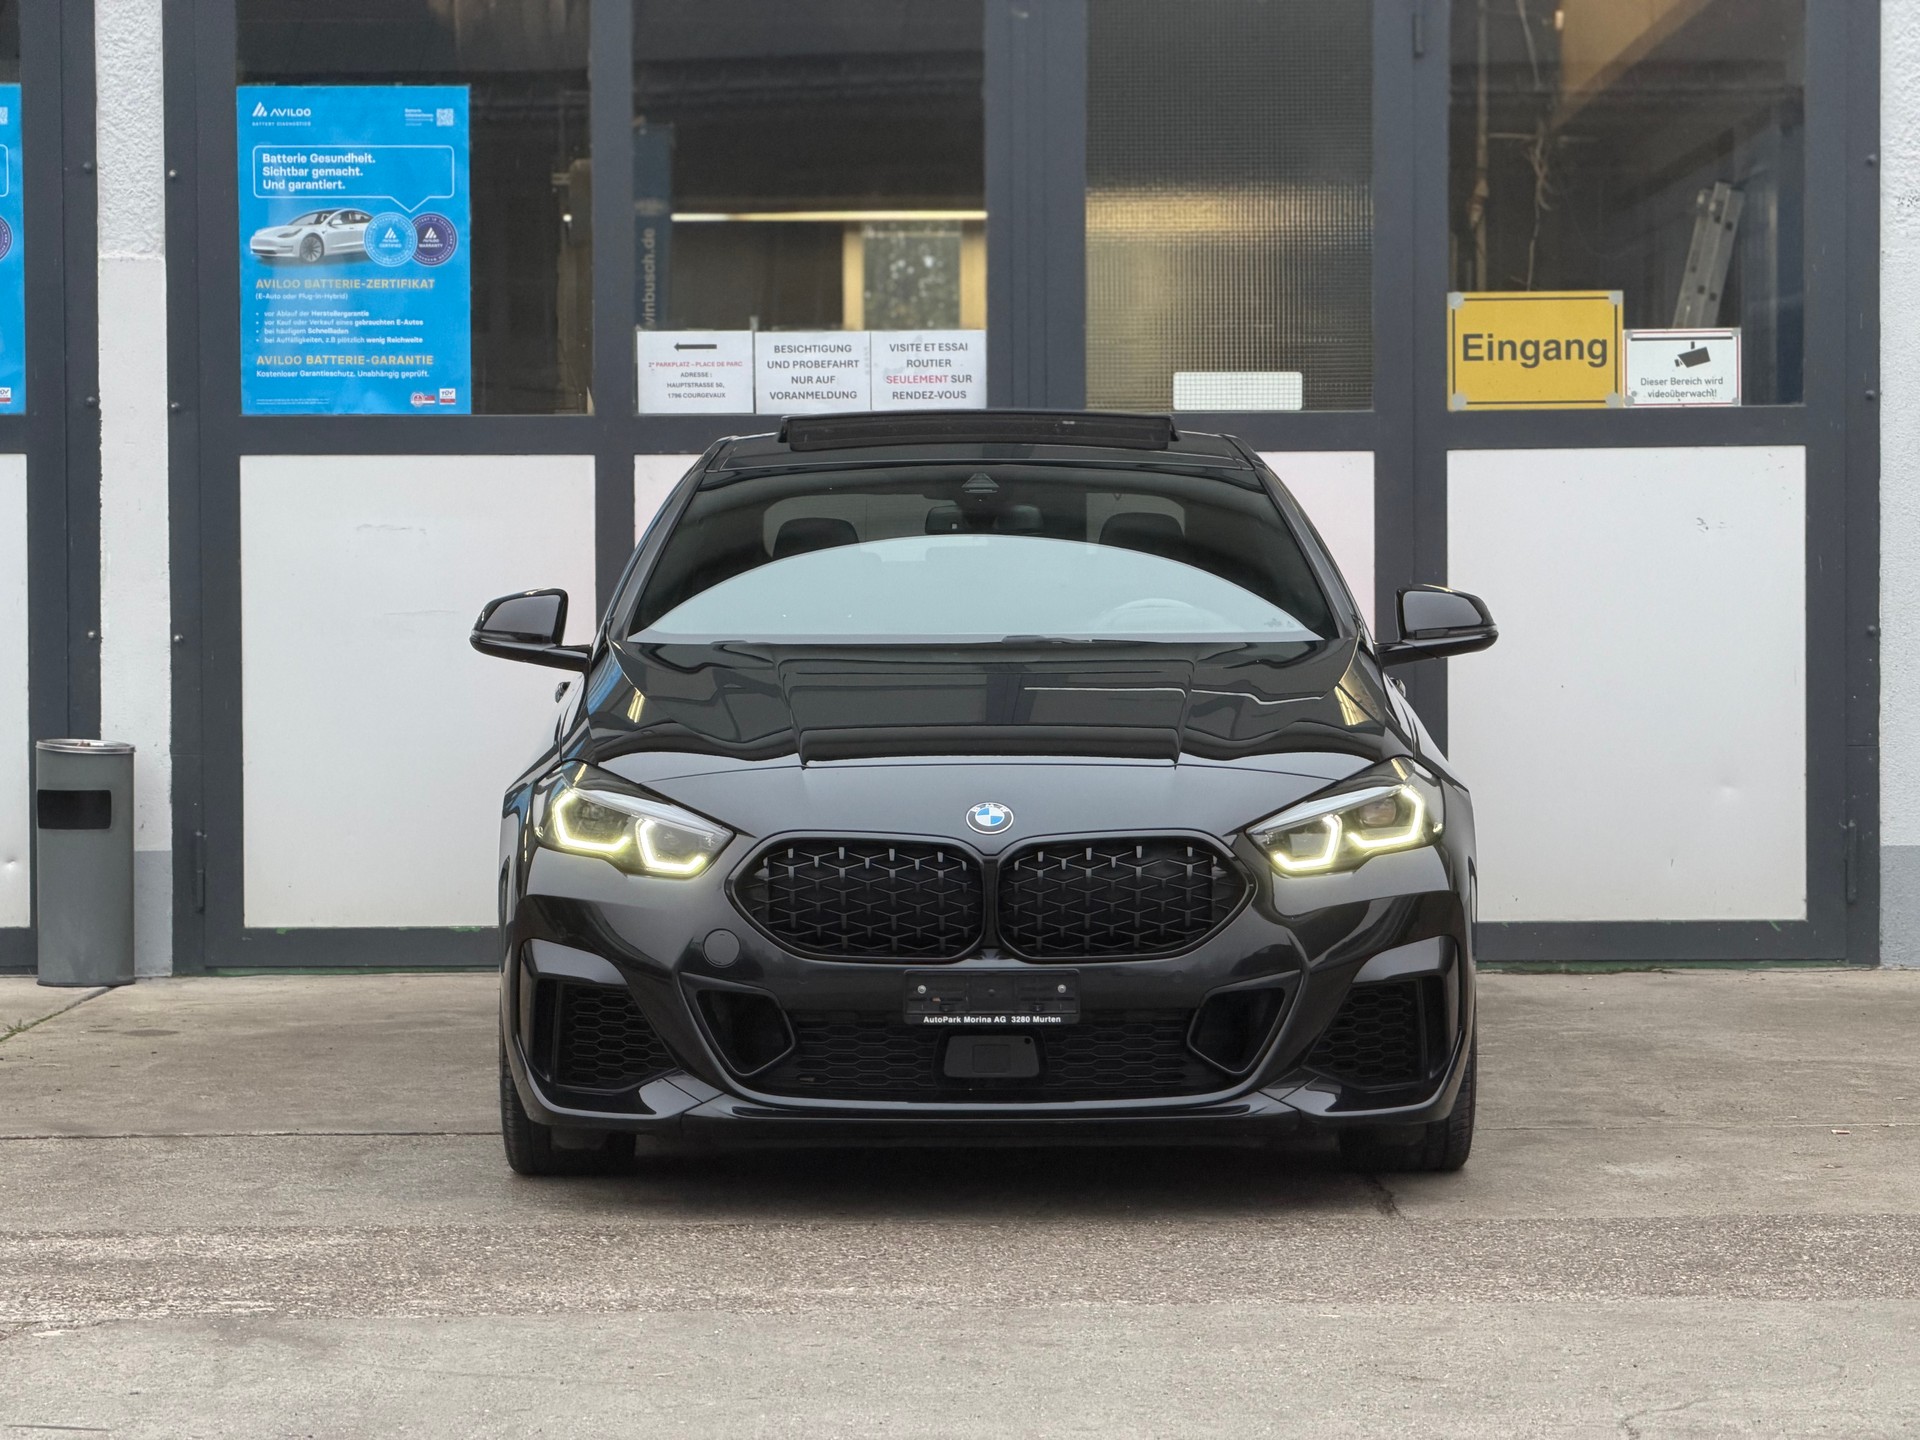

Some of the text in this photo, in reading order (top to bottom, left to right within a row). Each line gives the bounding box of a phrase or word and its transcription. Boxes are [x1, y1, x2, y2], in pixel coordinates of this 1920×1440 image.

[270, 108, 312, 117] AVILOO
[262, 153, 376, 164] Batterie Gesundheit.
[262, 166, 364, 179] Sichtbar gemacht.
[263, 179, 346, 192] Und garantiert.
[255, 279, 435, 289] AVILOO BATTERIE-ZERTIFIKAT
[354, 319, 395, 327] gebrauchten
[366, 336, 386, 345] wenig
[774, 344, 852, 354] BESICHTIGUNG
[889, 343, 968, 352] VISITE ET ESSAI
[1462, 332, 1608, 369] Eingang
[256, 355, 434, 365] AVILOO BATTERIE-GARANTIE
[767, 359, 860, 369] UND PROBEFAHRT
[906, 358, 952, 368] ROUTIER
[256, 370, 298, 378] Kostenloser
[357, 370, 399, 379] Unabhängig
[400, 370, 430, 379] geprüft.
[886, 374, 972, 384] SEULEMENT SUR
[791, 375, 836, 385] NUR AUF
[1640, 376, 1724, 386] Dieser Bereich wird
[769, 390, 858, 400] VORANMELDUNG
[892, 390, 967, 400] RENDEZ-VOUS
[1648, 389, 1717, 398] videoüberwacht!
[923, 1015, 1061, 1024] AutoPark Morina AG 3280 Murten
